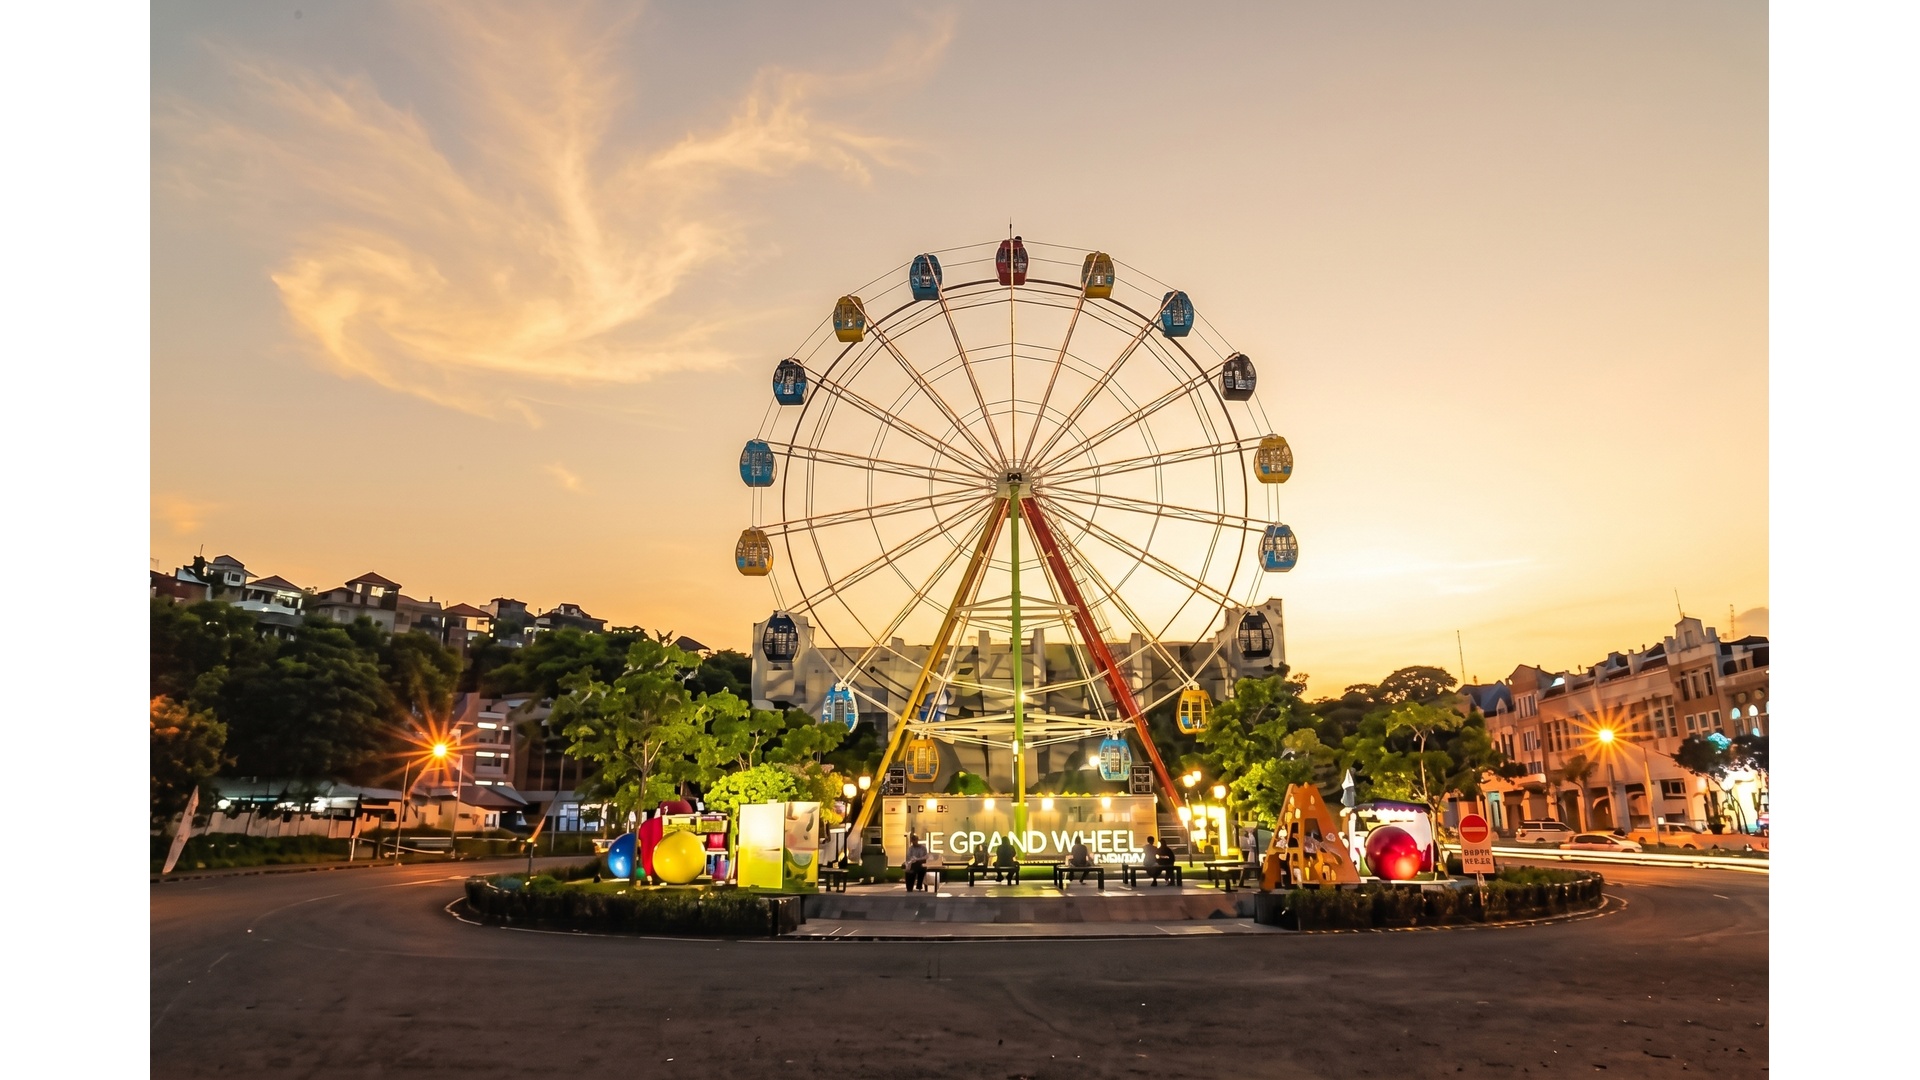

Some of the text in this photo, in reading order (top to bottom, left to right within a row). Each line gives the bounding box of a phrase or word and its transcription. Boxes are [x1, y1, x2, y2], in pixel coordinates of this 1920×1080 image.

[909, 829, 1144, 854] HE GRAND WHEEL
